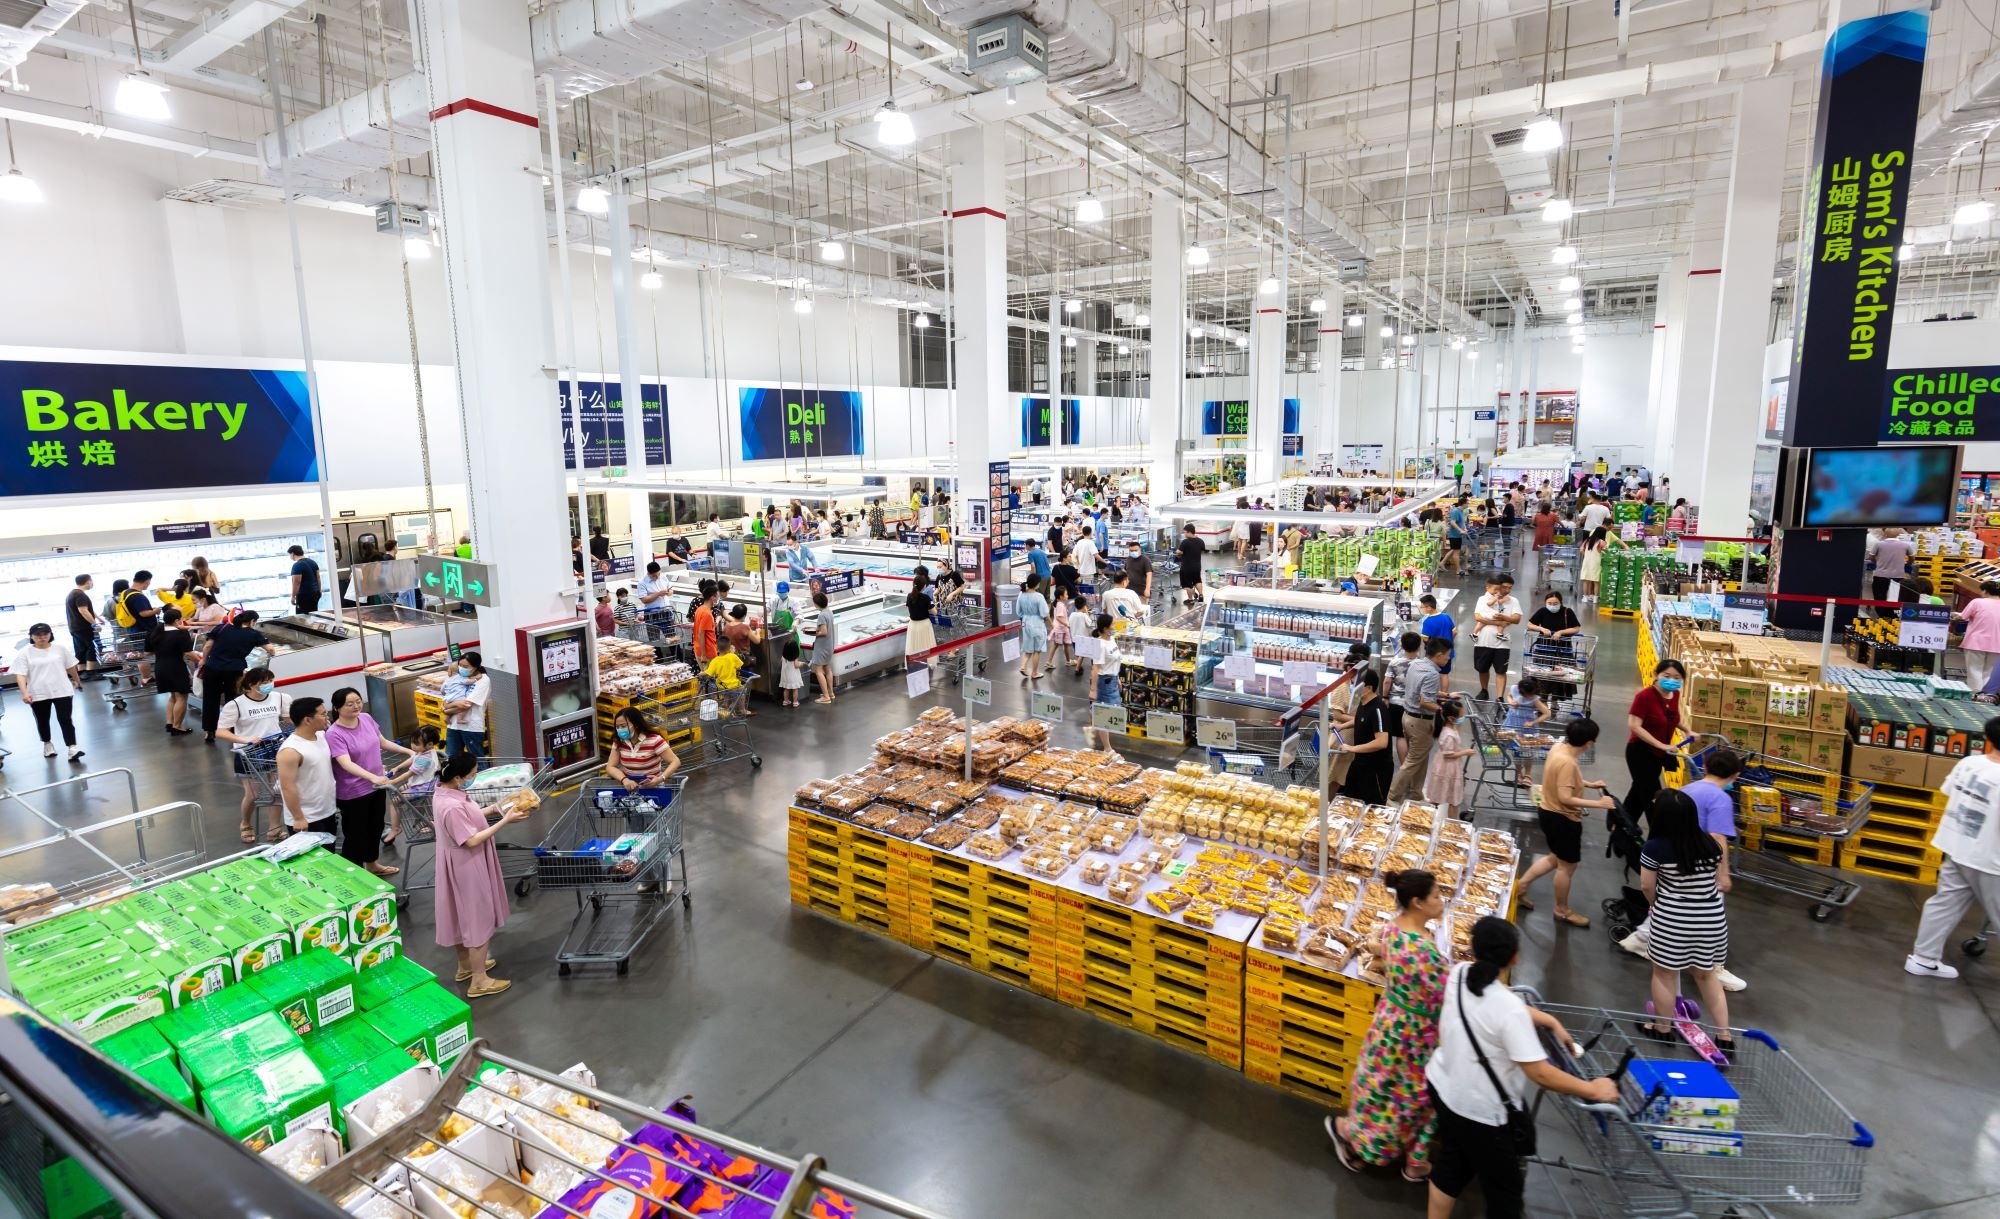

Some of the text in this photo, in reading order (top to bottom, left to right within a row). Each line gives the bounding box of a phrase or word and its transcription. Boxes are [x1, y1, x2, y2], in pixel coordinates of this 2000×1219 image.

[1821, 156, 1861, 263] 山姆厨房
[1849, 150, 1905, 361] Sam's Kitchen
[1227, 403, 1248, 414] Wal
[1891, 394, 1976, 416] Food
[22, 389, 248, 441] Bakery
[788, 403, 826, 426] Deli
[1227, 414, 1248, 424] Coo
[1888, 420, 1975, 436] 冷藏食品
[1731, 621, 1759, 631] 138.00
[1911, 635, 1944, 645] 138.00
[1209, 944, 1241, 961] LOSCAM
[1247, 957, 1281, 975] LOSCAM
[138, 987, 162, 1001] Calbee
